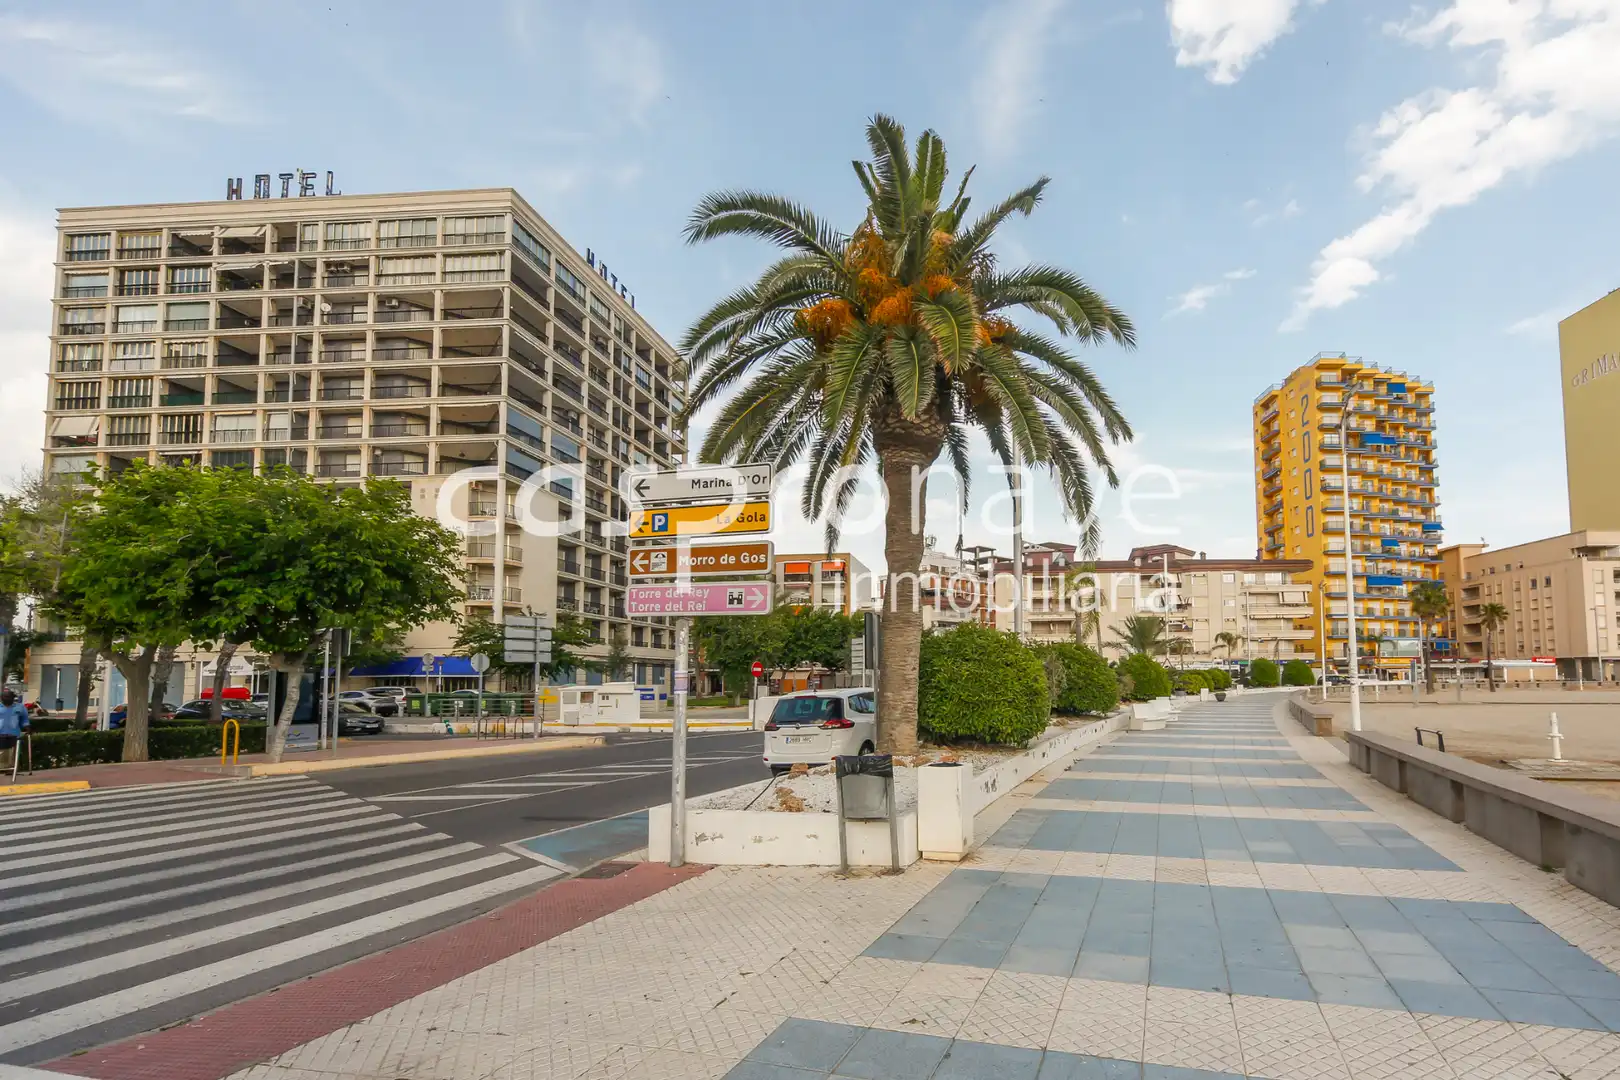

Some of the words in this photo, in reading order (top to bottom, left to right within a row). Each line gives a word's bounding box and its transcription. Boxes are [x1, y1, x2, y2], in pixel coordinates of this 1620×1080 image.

[227, 170, 341, 200] HOTEL
[1571, 352, 1620, 388] GRIMA
[1300, 394, 1315, 538] 2000
[691, 477, 733, 490] Marina
[738, 474, 768, 487] D'Or
[716, 514, 730, 525] La
[736, 511, 766, 523] Gola
[679, 554, 716, 567] Morro
[720, 553, 736, 565] de
[740, 552, 767, 564] Gos
[631, 588, 661, 599] Torre
[665, 587, 684, 599] del
[687, 587, 710, 601] Rey
[631, 601, 661, 612] Torre
[665, 601, 684, 612] del
[687, 600, 706, 612] Rei
